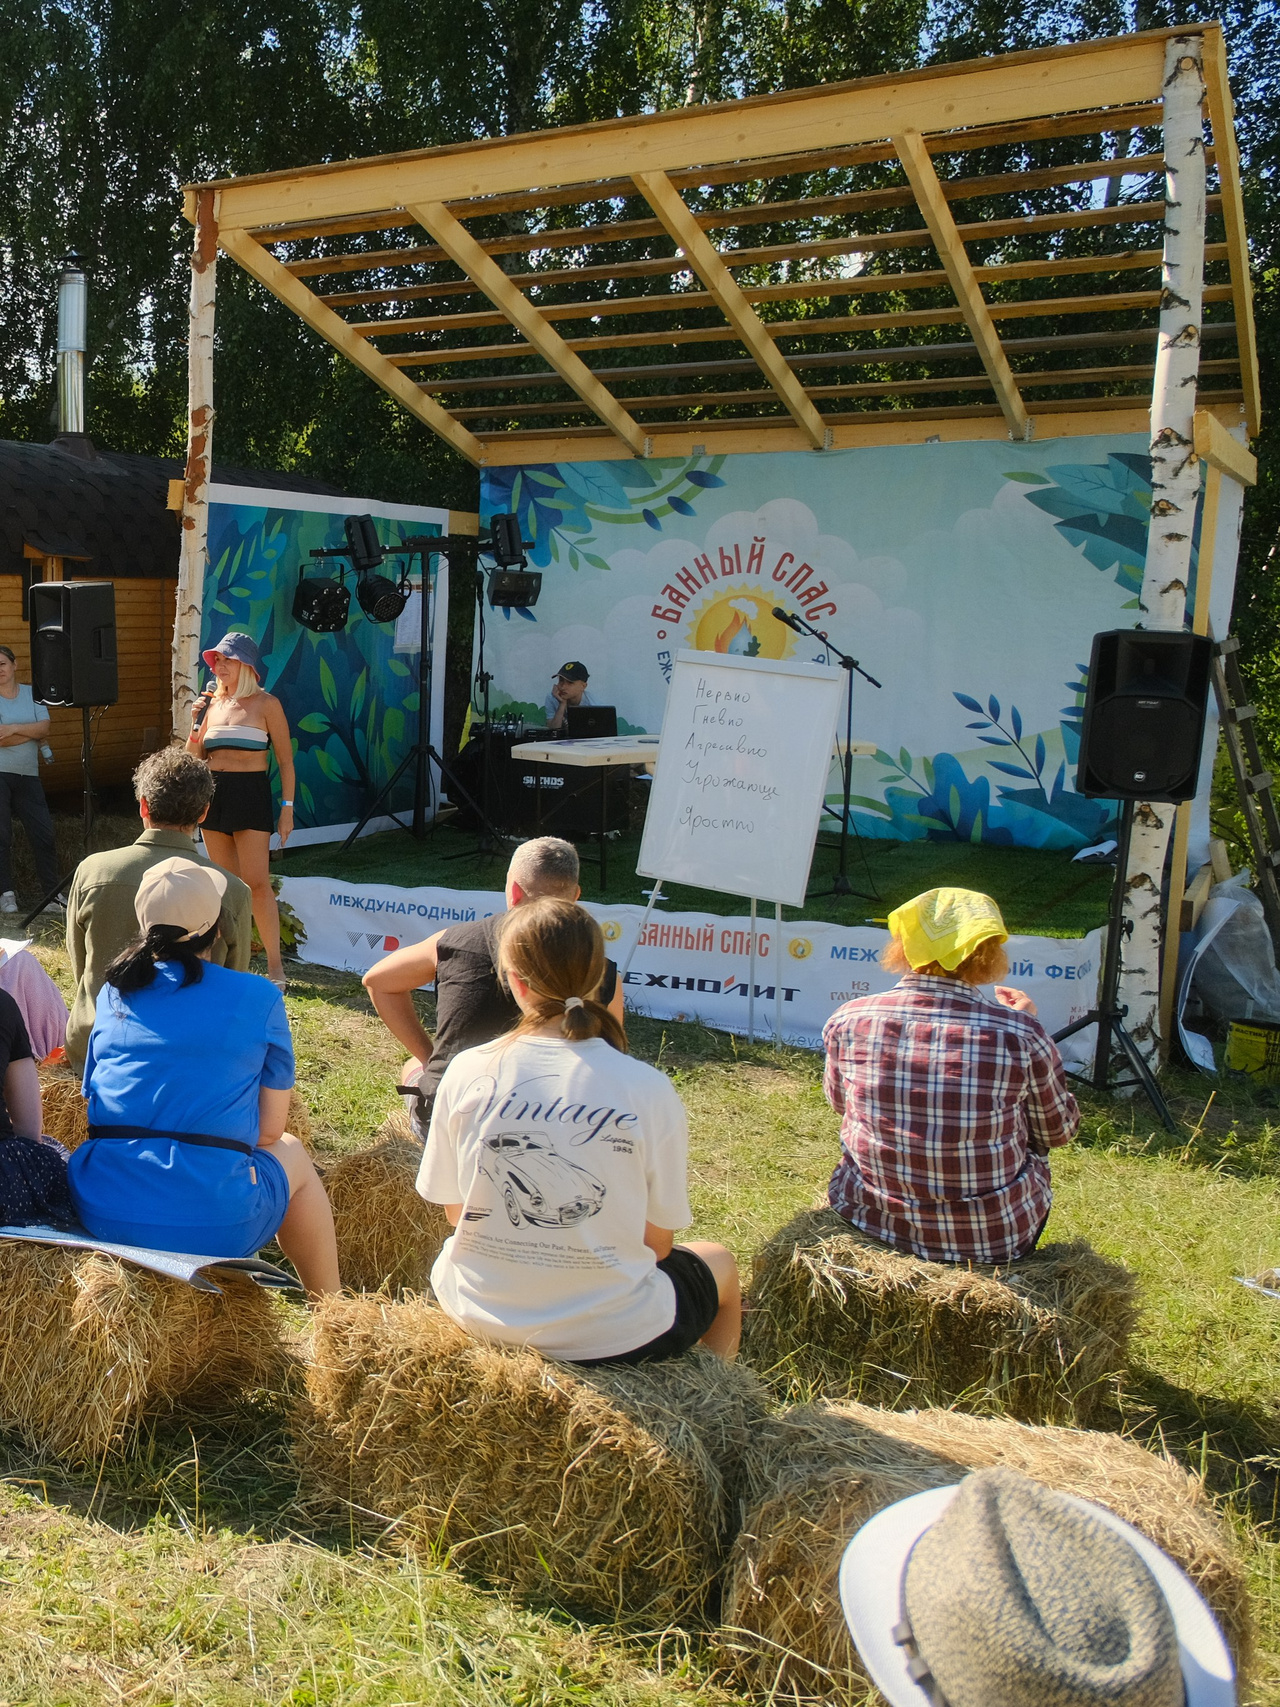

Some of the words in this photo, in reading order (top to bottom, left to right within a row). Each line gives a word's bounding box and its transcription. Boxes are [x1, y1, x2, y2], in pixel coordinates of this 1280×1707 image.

[651, 536, 766, 624] БАННЫЙ
[771, 552, 837, 621] СПАС
[695, 677, 751, 704] Нервно
[692, 704, 744, 727] Гневно
[679, 805, 755, 835] Яростно
[329, 894, 476, 922] МЕЖДУНАРОДНЫЙ
[618, 970, 802, 1002] ЕХНОЛИТ
[457, 1075, 638, 1147] Vintage
[504, 1238, 538, 1248] Connecting
[539, 1241, 551, 1249] Our
